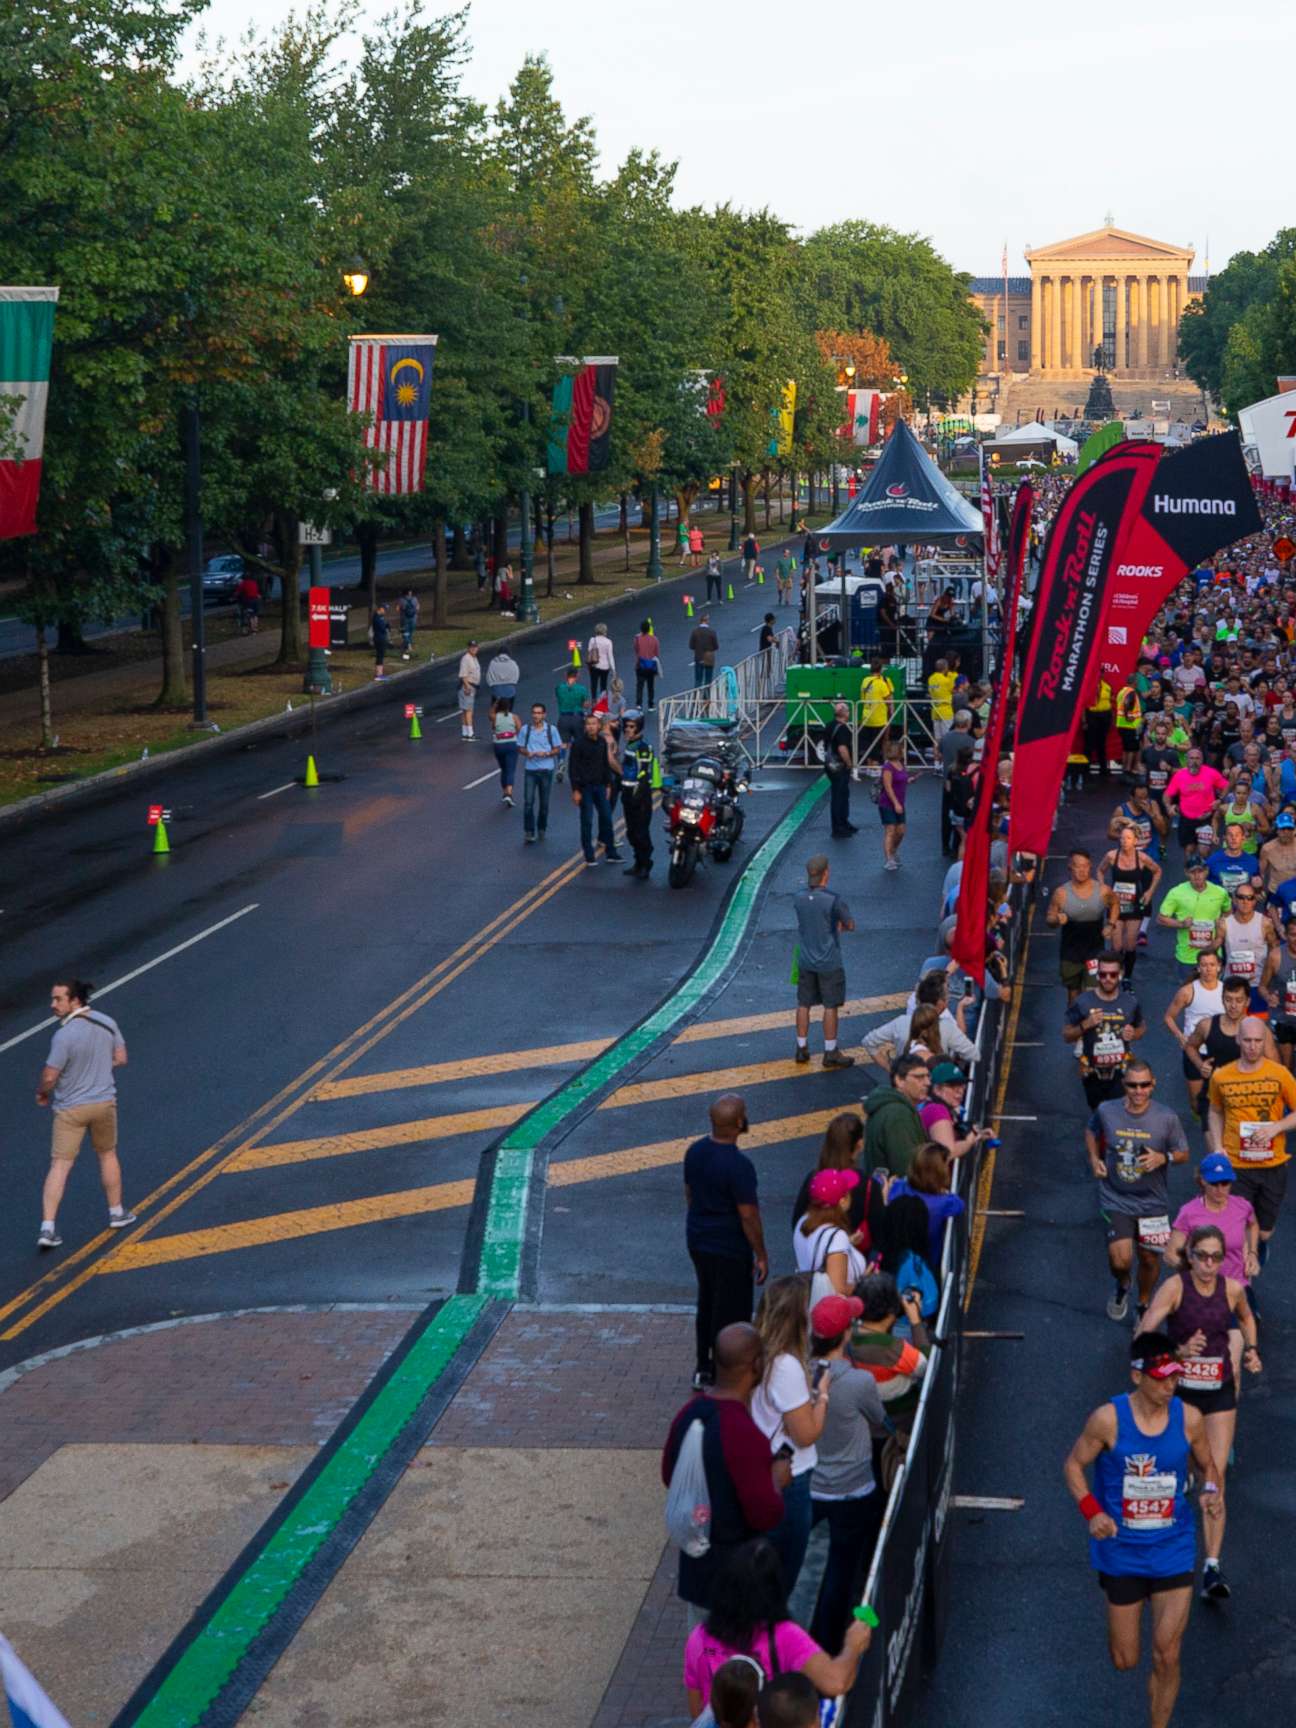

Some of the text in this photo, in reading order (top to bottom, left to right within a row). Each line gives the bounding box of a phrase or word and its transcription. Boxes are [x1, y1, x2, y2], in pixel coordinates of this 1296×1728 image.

[1153, 494, 1236, 516] Humana
[1116, 565, 1164, 577] ROOKS
[1062, 527, 1108, 691] MARATHON SERIES
[1183, 1362, 1219, 1376] 2426
[1127, 1500, 1170, 1514] 4547
